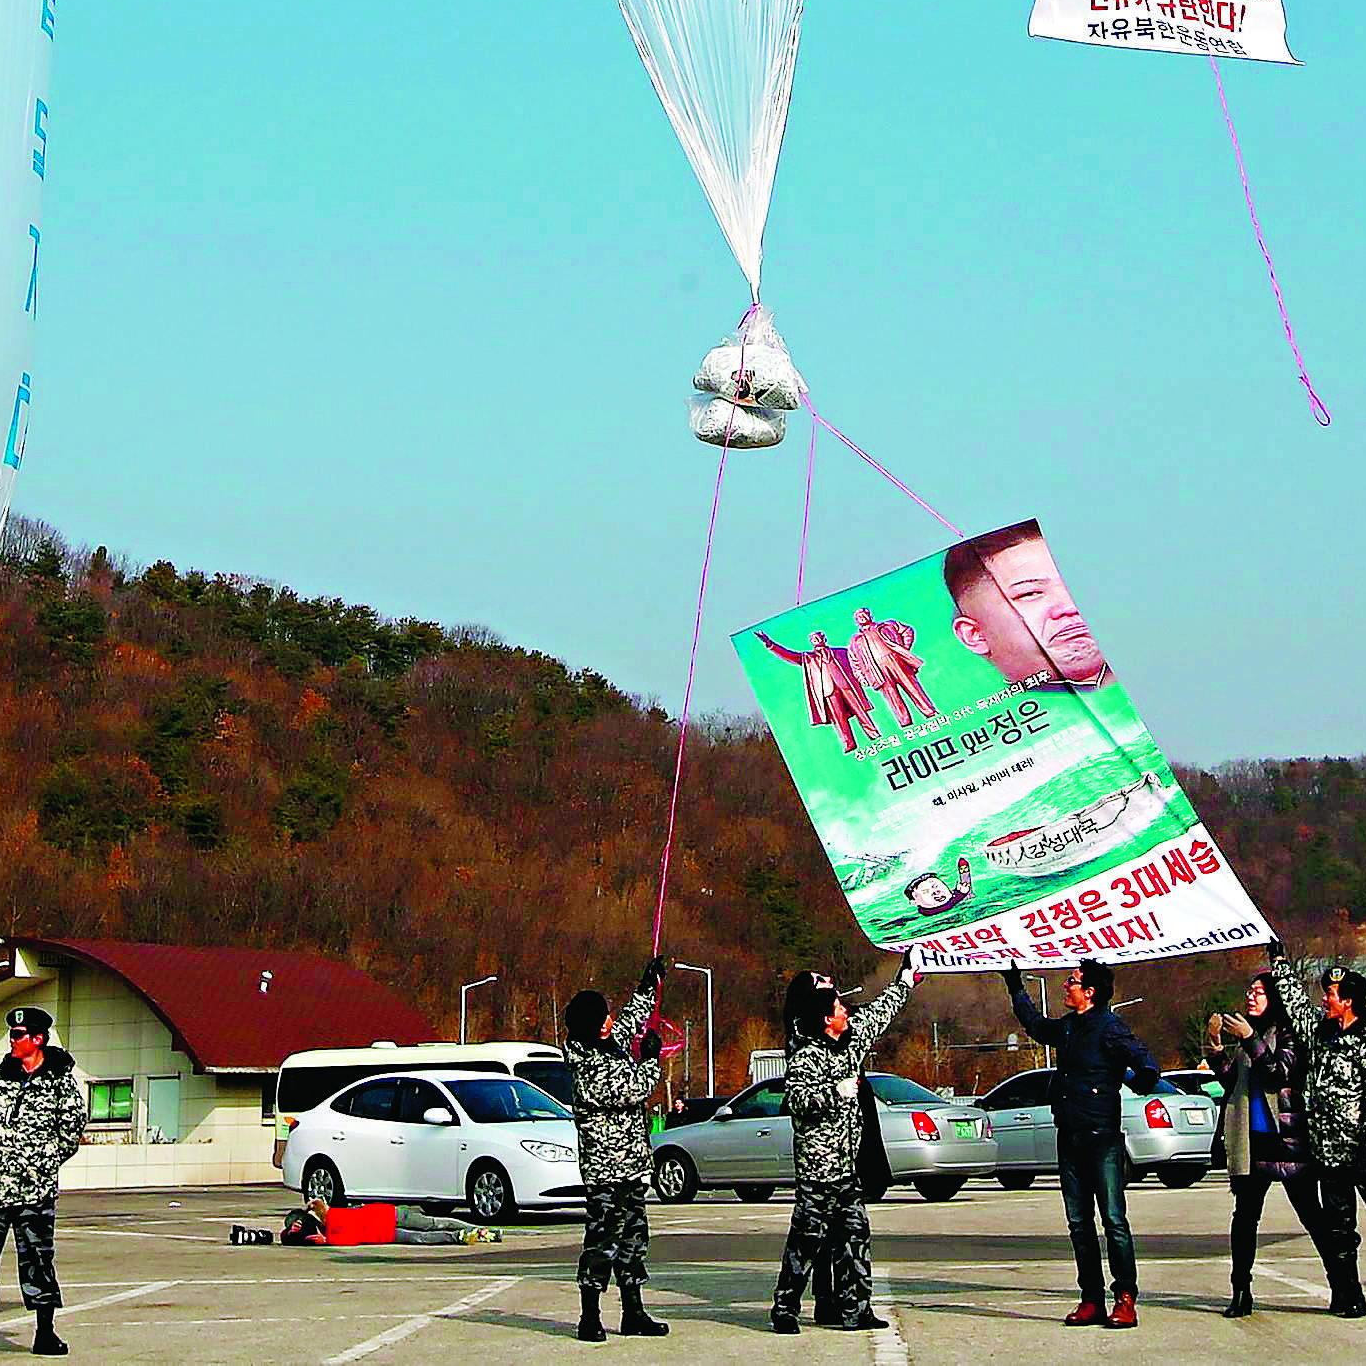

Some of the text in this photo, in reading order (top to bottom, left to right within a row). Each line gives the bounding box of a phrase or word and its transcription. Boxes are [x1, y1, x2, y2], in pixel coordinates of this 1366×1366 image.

[987, 700, 1051, 745] 정은
[1028, 817, 1098, 859] 강성대국
[946, 924, 1008, 952] 최악
[1019, 889, 1113, 939] 김정은
[1110, 839, 1221, 911] 3대세습
[1031, 910, 1165, 958] 끝장내자!
